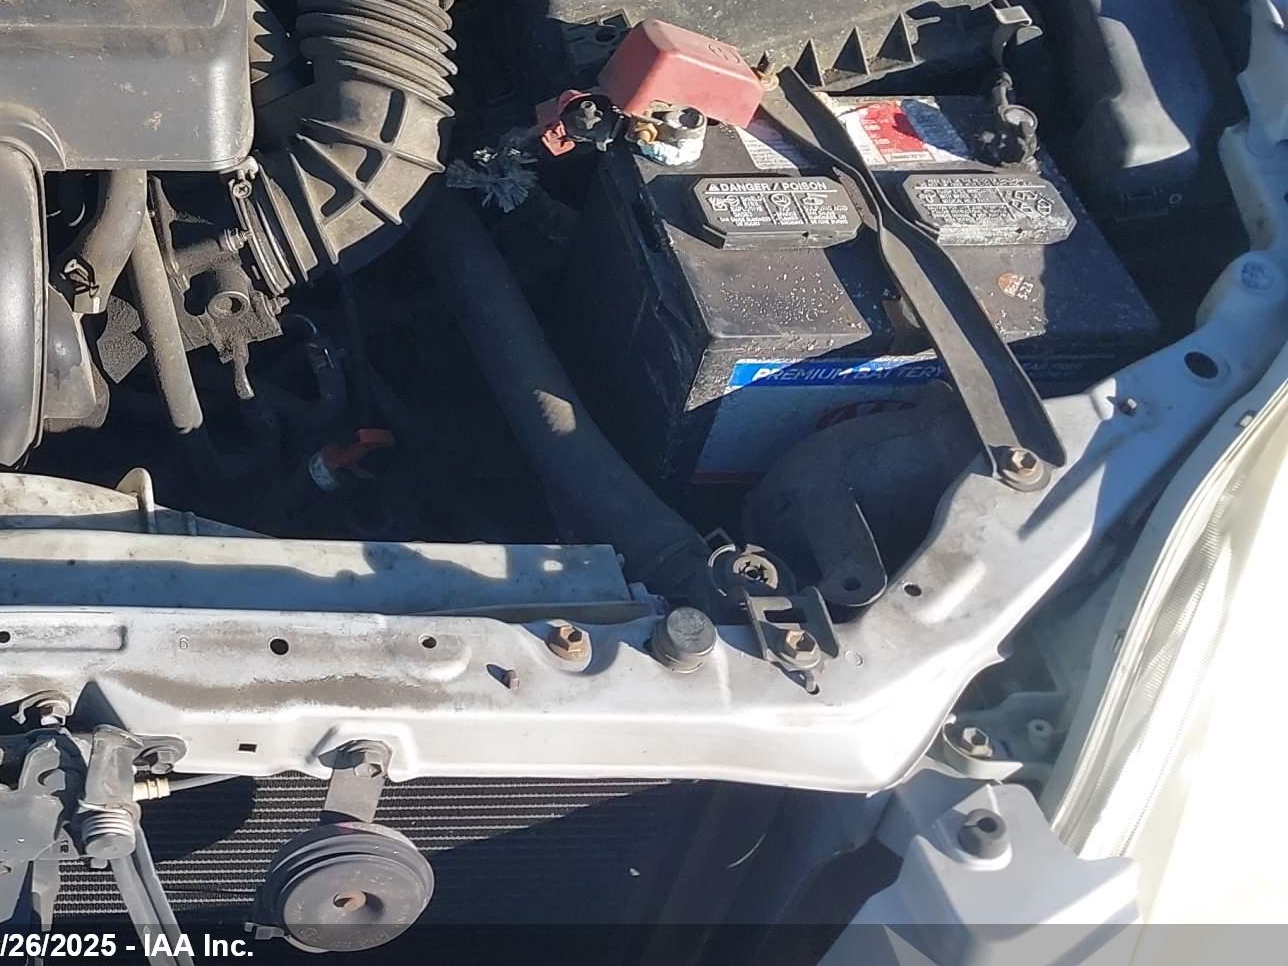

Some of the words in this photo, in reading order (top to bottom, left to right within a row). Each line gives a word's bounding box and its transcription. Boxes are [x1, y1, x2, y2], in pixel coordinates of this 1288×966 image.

[719, 183, 772, 192] DANGER
[782, 181, 828, 191] POISON
[752, 367, 851, 381] PREMIUM
[854, 365, 944, 380] BATTERY
